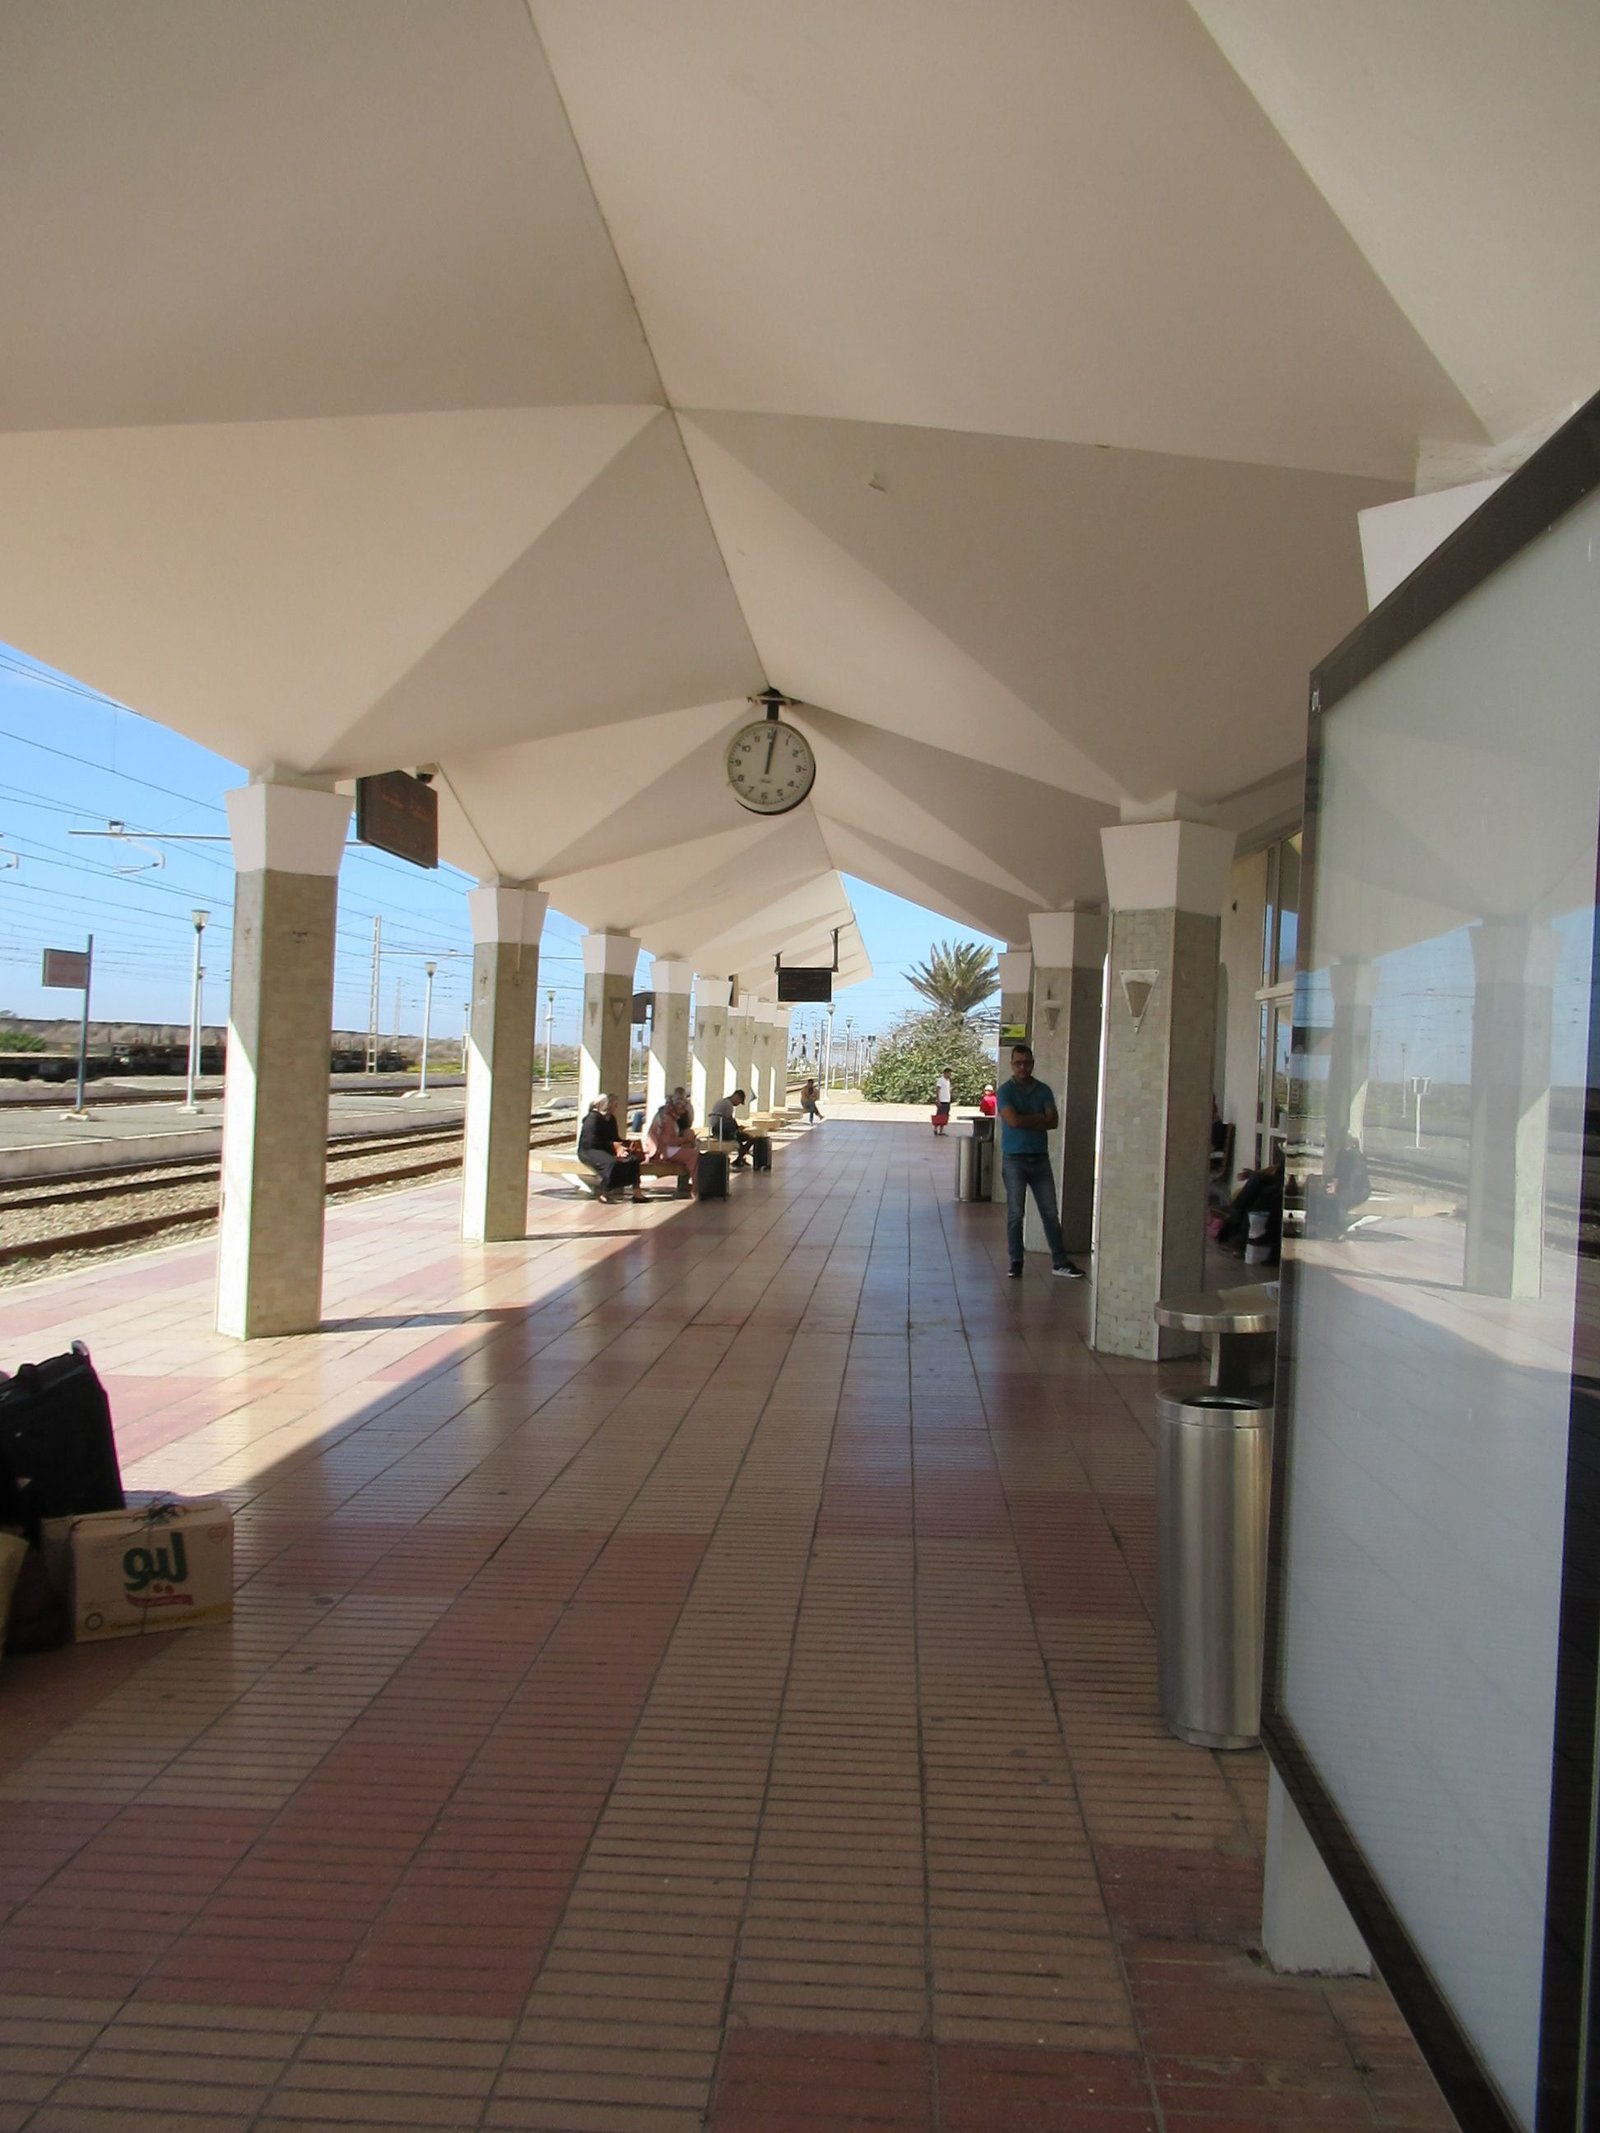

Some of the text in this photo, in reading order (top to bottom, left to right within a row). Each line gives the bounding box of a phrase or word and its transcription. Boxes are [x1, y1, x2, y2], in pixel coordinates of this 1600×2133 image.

[792, 749, 799, 757] 2
[795, 765, 802, 773] 3
[737, 774, 744, 782] 8
[761, 792, 768, 800] 6
[777, 788, 783, 797] 5
